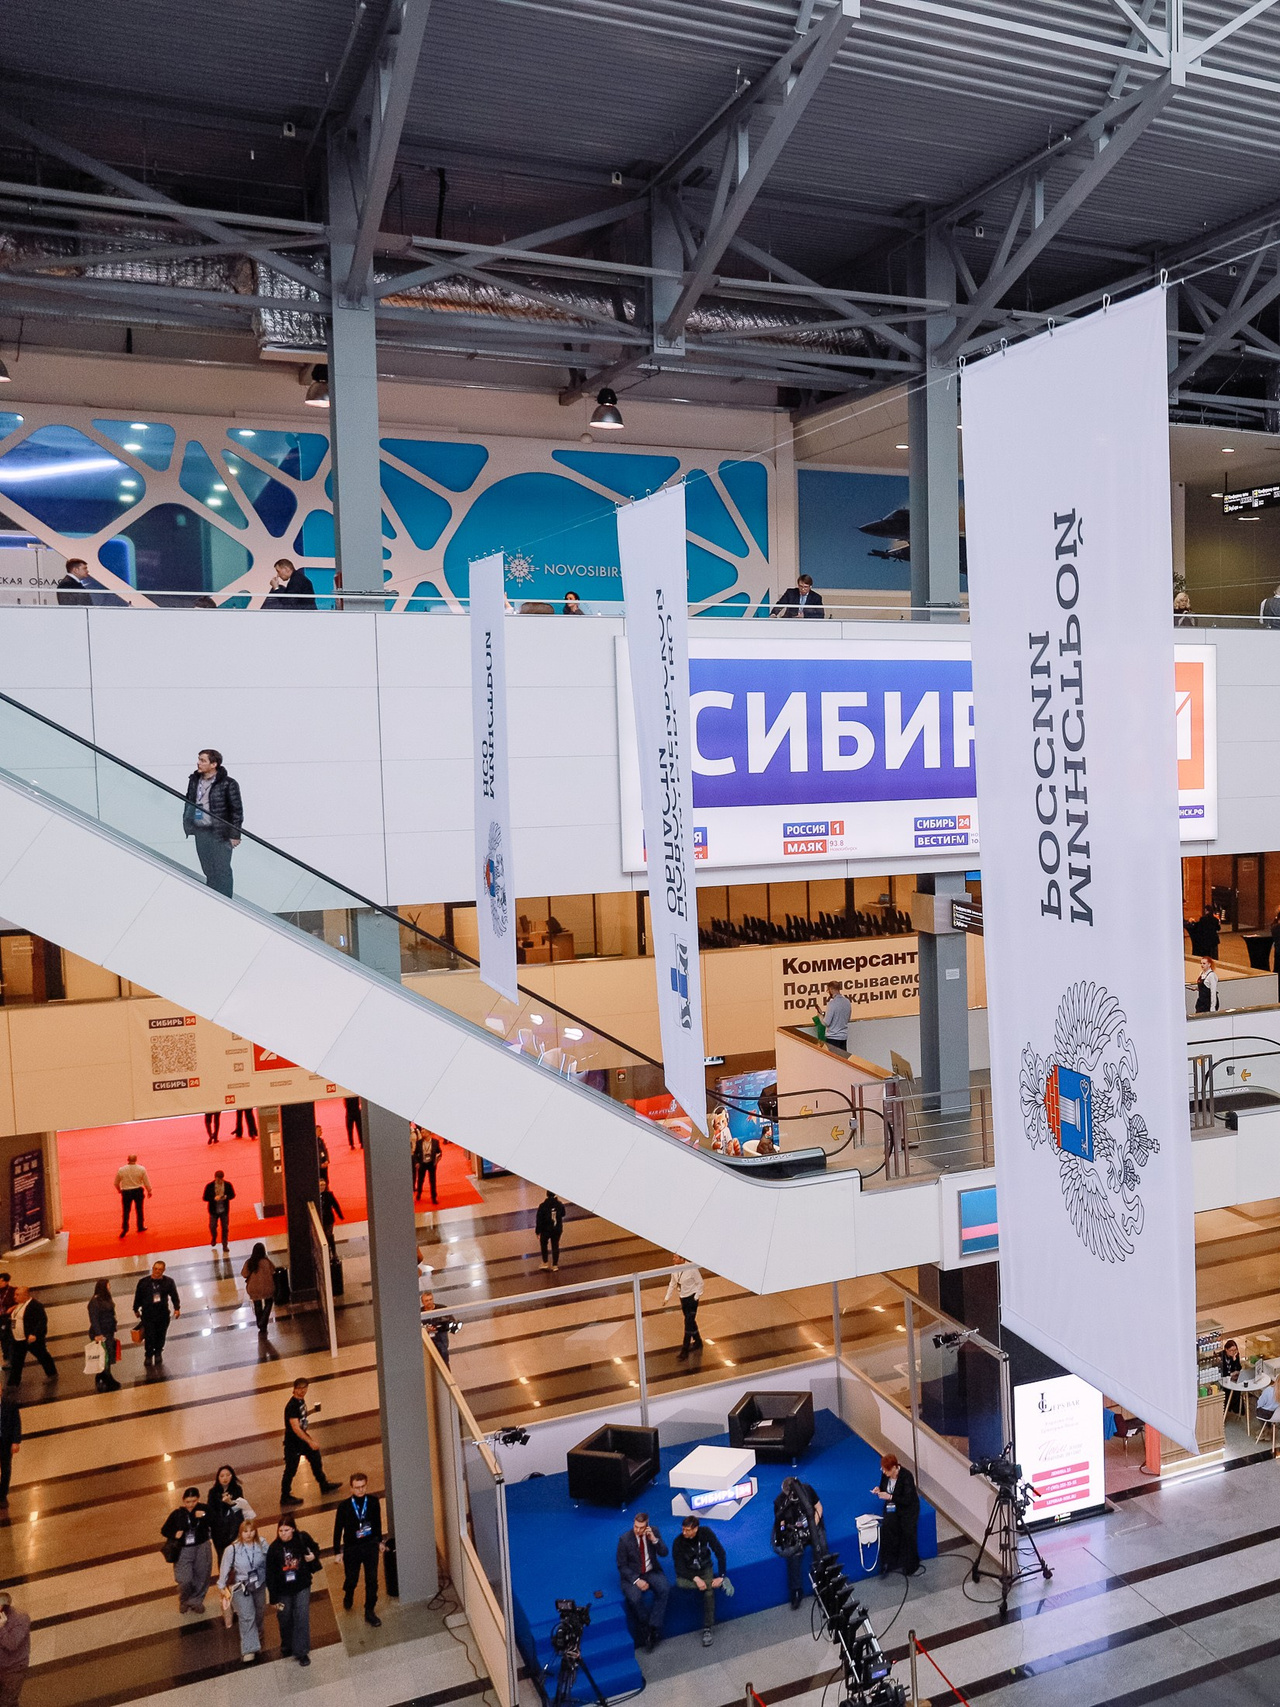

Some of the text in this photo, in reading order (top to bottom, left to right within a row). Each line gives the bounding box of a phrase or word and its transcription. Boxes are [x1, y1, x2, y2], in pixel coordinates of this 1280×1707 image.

[917, 818, 955, 829] СИБИРЬ
[786, 824, 826, 835] РОССИЯ
[787, 841, 823, 853] МАЯК
[150, 1019, 183, 1028] СИБИРЬ
[154, 1080, 187, 1090] СИБИРЬ
